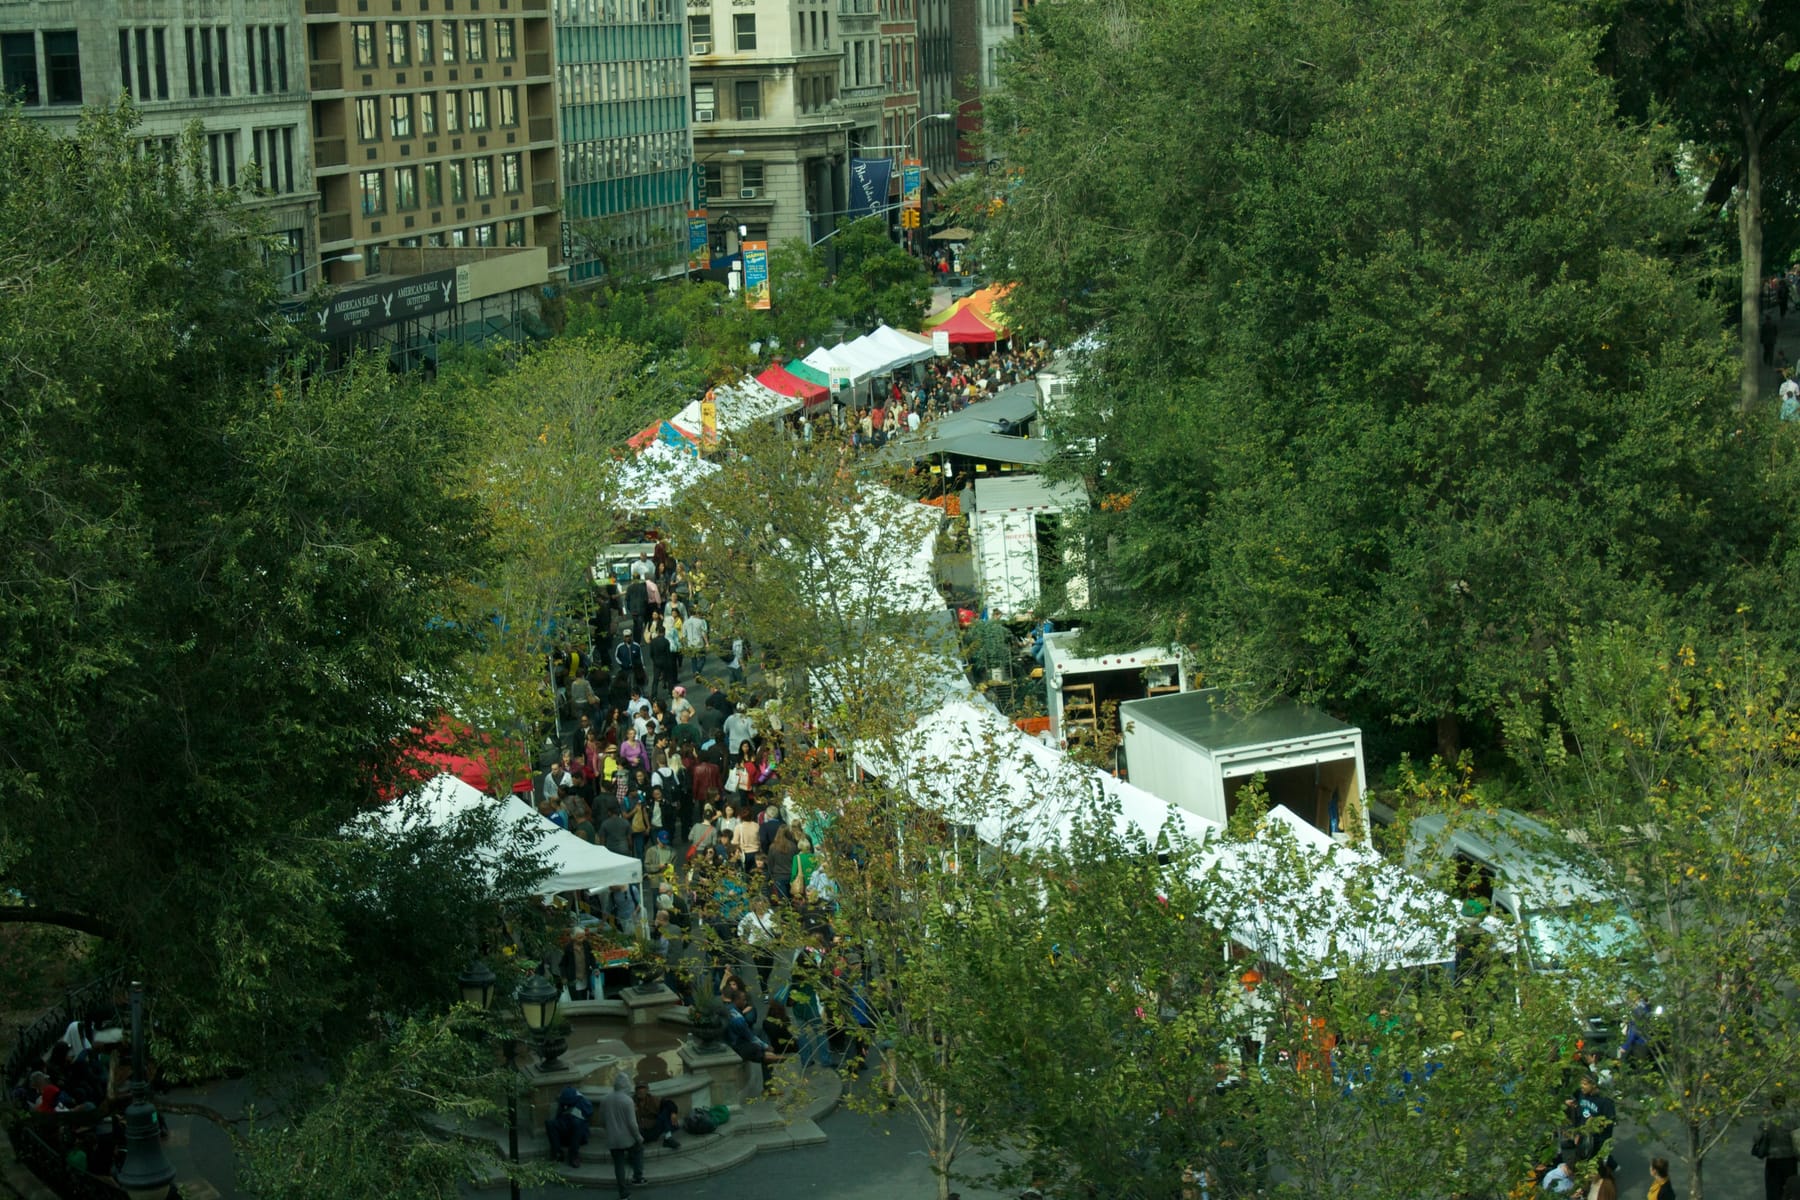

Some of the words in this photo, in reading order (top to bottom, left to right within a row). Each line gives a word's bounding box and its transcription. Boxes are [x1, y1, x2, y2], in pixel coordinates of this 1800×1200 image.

[854, 162, 867, 183] Blue
[397, 284, 423, 298] AMERICAN
[423, 280, 439, 293] EAGLE
[334, 298, 362, 314] AMERICAN
[362, 293, 379, 307] EAGLE
[406, 293, 431, 306] OUTFITTERS
[343, 307, 370, 321] OUTFITTERS
